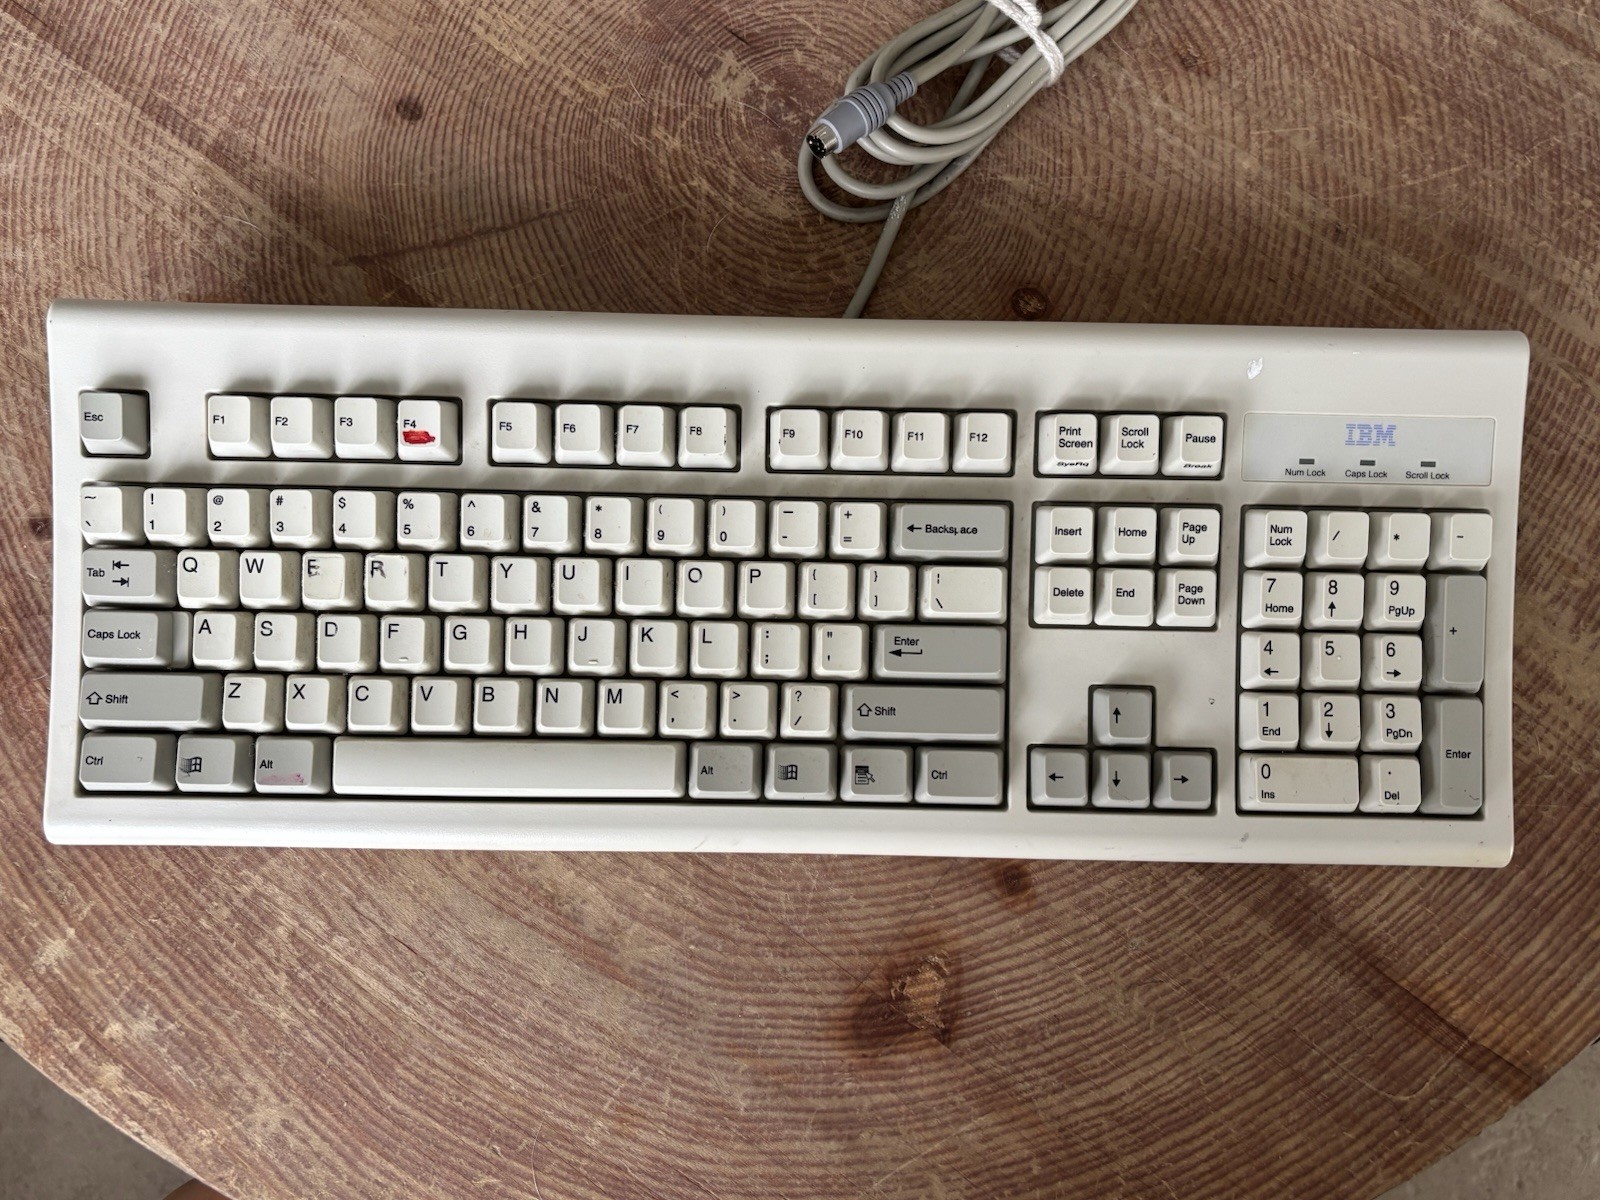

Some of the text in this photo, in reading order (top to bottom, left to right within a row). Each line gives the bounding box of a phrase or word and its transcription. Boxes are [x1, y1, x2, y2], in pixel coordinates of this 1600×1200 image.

[84, 412, 103, 421] Esc
[213, 415, 224, 424] F1
[276, 417, 288, 426] F2
[340, 417, 352, 426] F3
[404, 420, 416, 428] F4
[500, 422, 512, 431] F5
[564, 424, 575, 433] F6
[627, 425, 638, 433] F7
[690, 427, 702, 435] F8
[783, 429, 795, 438] F9
[845, 430, 863, 438] F10
[1059, 426, 1081, 435] Print
[1122, 427, 1148, 436] Scroll
[1345, 424, 1396, 446] IBM
[908, 432, 923, 440] F11
[970, 433, 987, 442] F12
[1186, 434, 1216, 443] Pause
[1059, 438, 1093, 448] Screen
[1121, 439, 1144, 448] Lock
[1345, 470, 1366, 478] Caps
[1406, 471, 1428, 479] Scroll
[150, 494, 154, 504] !
[213, 495, 223, 505] @
[275, 496, 284, 505] #
[338, 497, 346, 509] $
[403, 499, 414, 509] %
[467, 500, 476, 508] ^
[532, 502, 541, 512] &
[843, 510, 853, 519] +
[149, 520, 155, 530] 1
[213, 521, 222, 531] 2
[276, 522, 285, 532] 3
[338, 524, 347, 533] 4
[403, 524, 412, 534] 5
[1183, 522, 1207, 533] Page
[1271, 525, 1292, 533] Num
[466, 526, 475, 536] 6
[531, 527, 540, 537] 7
[594, 529, 602, 539] 8
[657, 530, 665, 540] 9
[1055, 527, 1082, 535] Insert
[1119, 528, 1147, 537] Home
[1332, 531, 1341, 540] /
[719, 531, 728, 542] 0
[1182, 535, 1195, 545] Up
[1270, 537, 1291, 545] Lock
[183, 557, 197, 572] Q
[245, 558, 264, 573] W
[308, 559, 319, 577] E
[371, 561, 385, 577] R
[436, 562, 448, 576] T
[87, 568, 105, 577] Tab
[500, 563, 513, 578] Y
[563, 565, 575, 580] U
[688, 568, 702, 583] O
[750, 569, 761, 583] P
[1179, 584, 1203, 595] Page
[1267, 578, 1276, 592] 7
[1328, 580, 1338, 595] 8
[1390, 581, 1399, 595] 9
[1053, 588, 1084, 597] Delete
[1116, 588, 1134, 597] End
[935, 598, 943, 608] \
[1178, 596, 1205, 605] Down
[1266, 604, 1293, 613] Home
[1389, 606, 1415, 617] PgUp
[198, 619, 211, 634] A
[261, 621, 272, 636] S
[325, 622, 337, 637] D
[388, 624, 399, 638] F
[515, 624, 527, 639] H
[1449, 626, 1458, 636] +
[88, 629, 140, 640] Caps Lock
[453, 625, 466, 640] G
[578, 627, 587, 641] J
[642, 627, 653, 642] K
[703, 629, 712, 643] L
[765, 630, 770, 639] :
[826, 631, 833, 639] "
[894, 636, 919, 646] Enter
[1264, 640, 1273, 655] 4
[1325, 641, 1335, 655] 5
[1386, 642, 1396, 657] 6
[764, 654, 769, 664] ;
[228, 683, 241, 698] Z
[293, 684, 305, 699] X
[356, 686, 369, 701] C
[421, 686, 433, 701] V
[482, 687, 494, 702] B
[546, 688, 558, 703] N
[670, 690, 679, 699] <
[732, 691, 741, 700] >
[106, 694, 128, 703] Shift
[607, 689, 622, 704] M
[794, 691, 803, 701] ?
[875, 706, 895, 715] Shift
[1262, 702, 1269, 716] 1
[1324, 702, 1333, 717] 2
[1386, 703, 1395, 718] 3
[793, 716, 802, 725] /
[1263, 727, 1280, 735] End
[1387, 729, 1412, 739] PgDn
[1446, 750, 1471, 758] Enter
[86, 756, 103, 765] Ctrl
[260, 760, 273, 768] Alt
[701, 766, 713, 774] Alt
[932, 770, 947, 779] Ctrl
[1261, 764, 1270, 779] 0
[1262, 790, 1275, 798] Ins
[1385, 791, 1399, 800] Del
